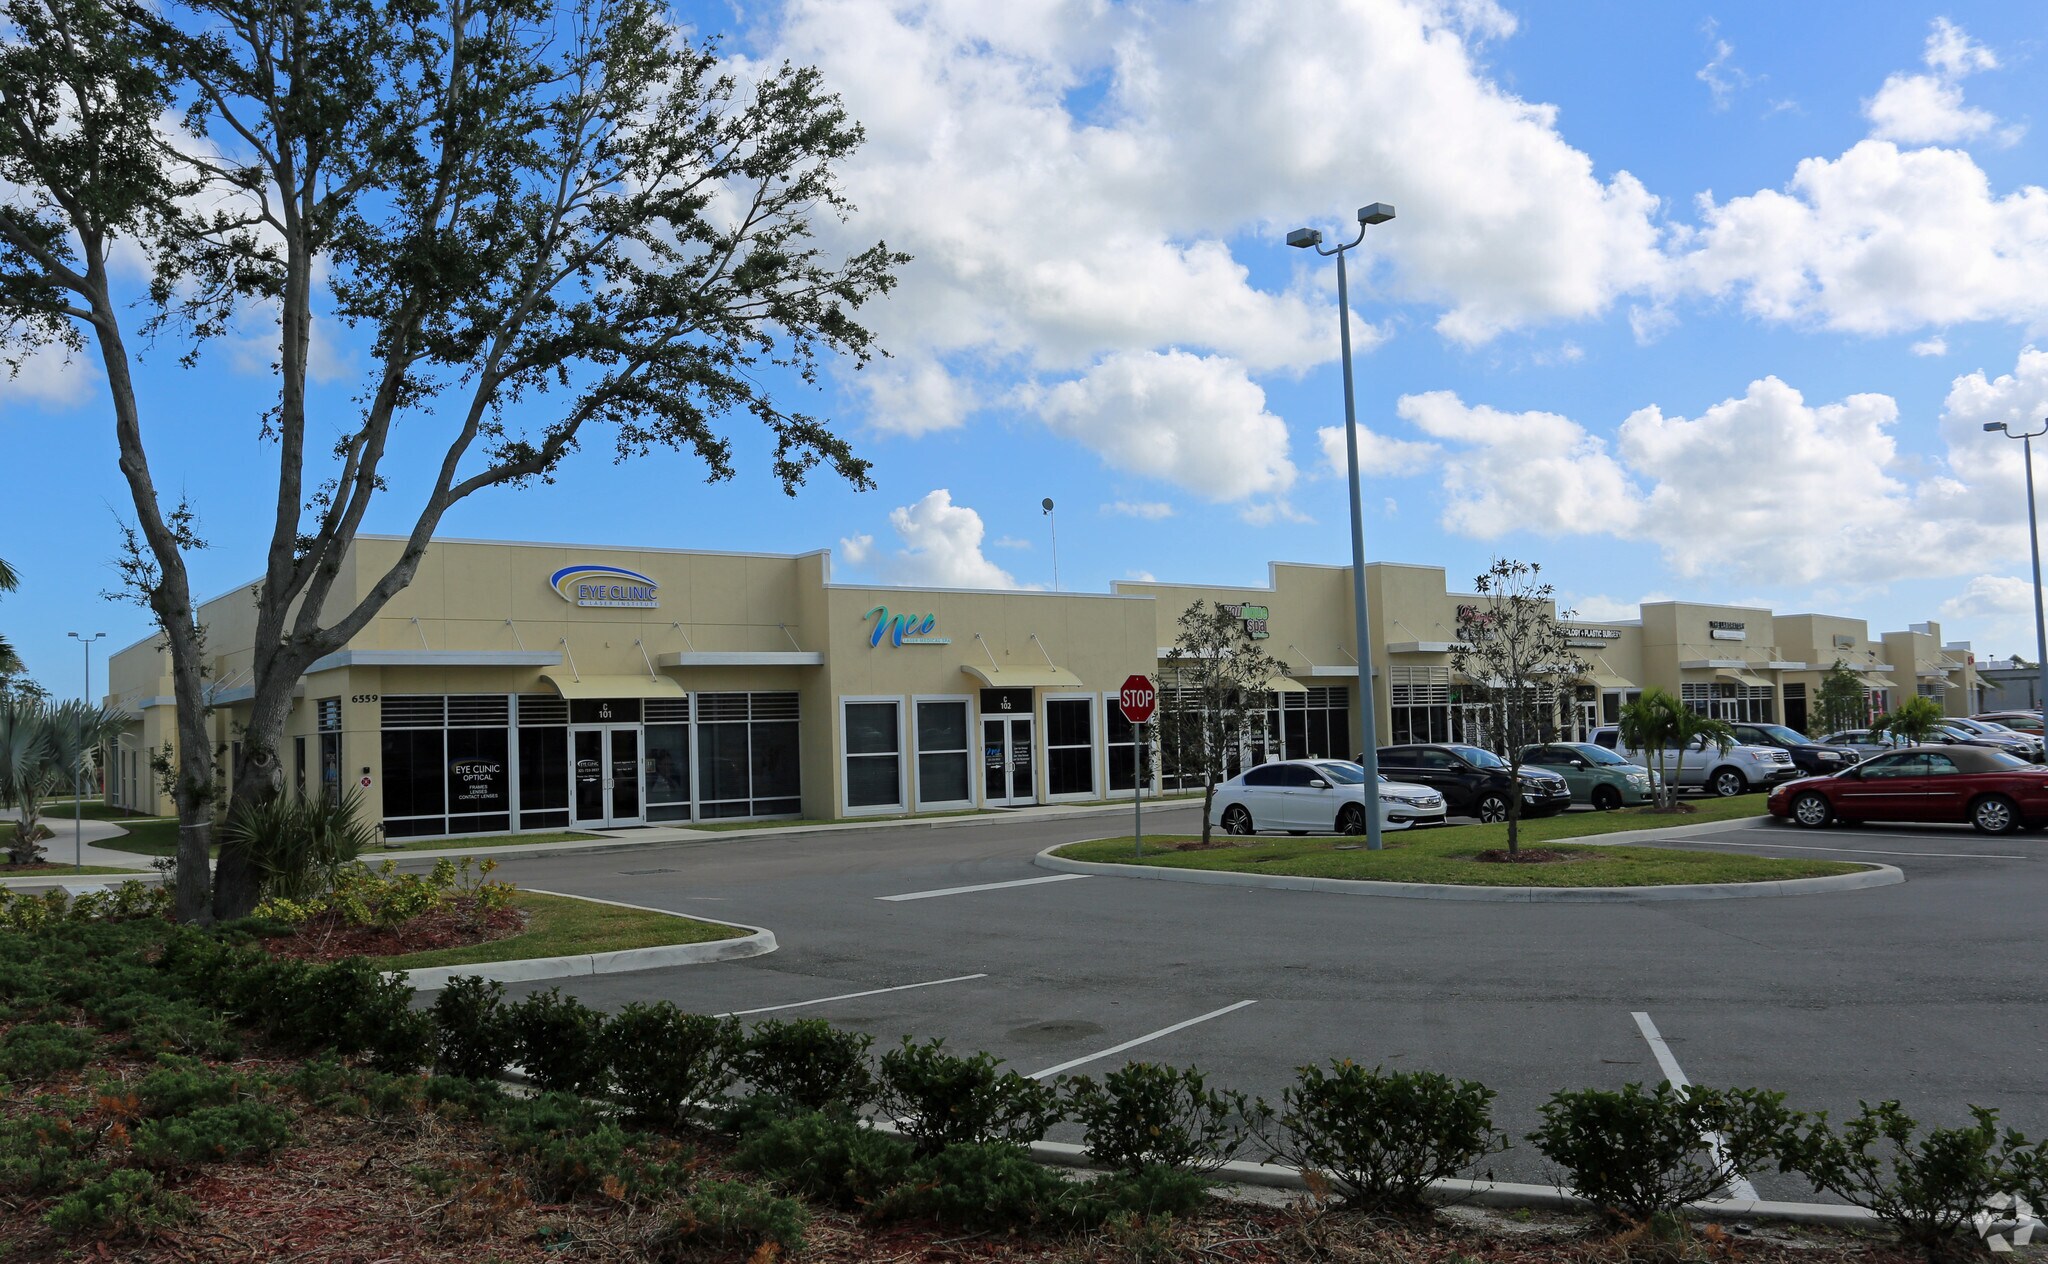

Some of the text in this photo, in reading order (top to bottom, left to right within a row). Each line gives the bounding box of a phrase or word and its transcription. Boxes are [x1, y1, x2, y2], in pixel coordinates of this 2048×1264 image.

[579, 585, 658, 600] EYE CLINIC
[1247, 619, 1267, 632] spa
[1603, 630, 1621, 639] SURGERY
[351, 694, 378, 703] 6559
[1122, 689, 1154, 707] STOP
[602, 703, 608, 711] C
[598, 710, 613, 718] 101
[455, 765, 500, 774] EYE CLINIC
